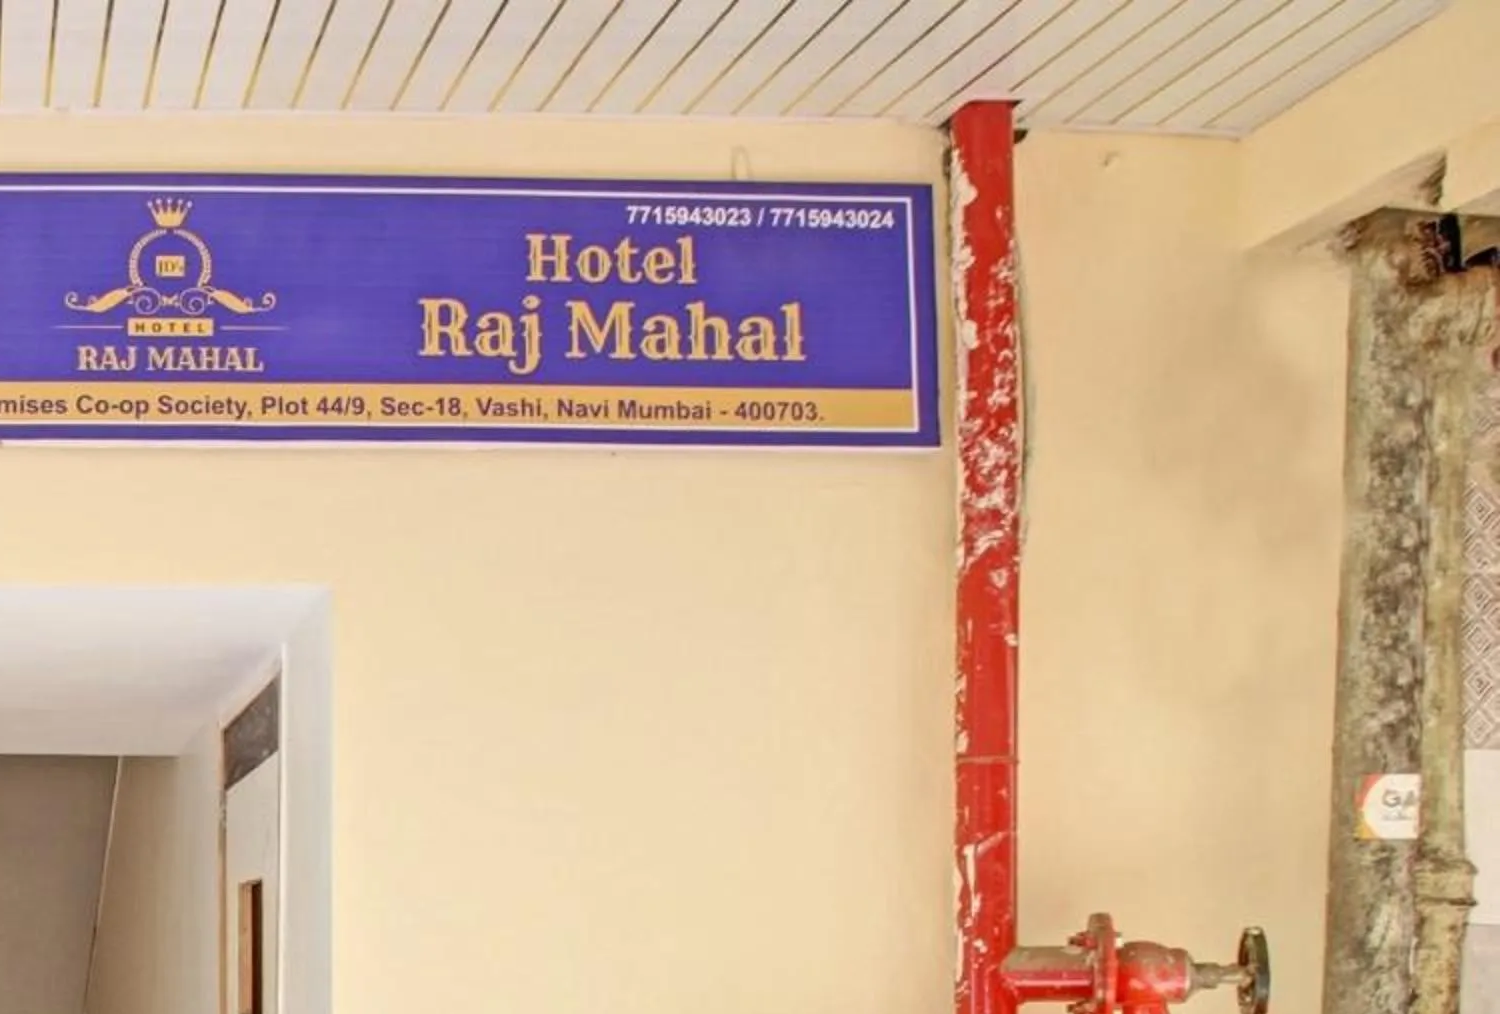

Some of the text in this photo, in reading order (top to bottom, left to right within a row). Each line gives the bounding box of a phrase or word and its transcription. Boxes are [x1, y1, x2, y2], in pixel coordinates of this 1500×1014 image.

[626, 205, 895, 229] 7715943023 / 7715943024
[525, 233, 697, 284] Hotel
[134, 321, 205, 334] HOTEL
[419, 295, 806, 375] Raj Mahal
[77, 346, 264, 372] RAJ MAHAL
[75, 395, 150, 420] Co-op
[157, 395, 253, 420] Society,
[261, 396, 309, 415] Plot
[315, 396, 372, 419] 44/9,
[380, 396, 468, 420] Sec-18,
[475, 397, 549, 420] Vashi,
[557, 398, 609, 417] Navi
[617, 399, 712, 419] Mumbai
[734, 400, 824, 421] 400703.
